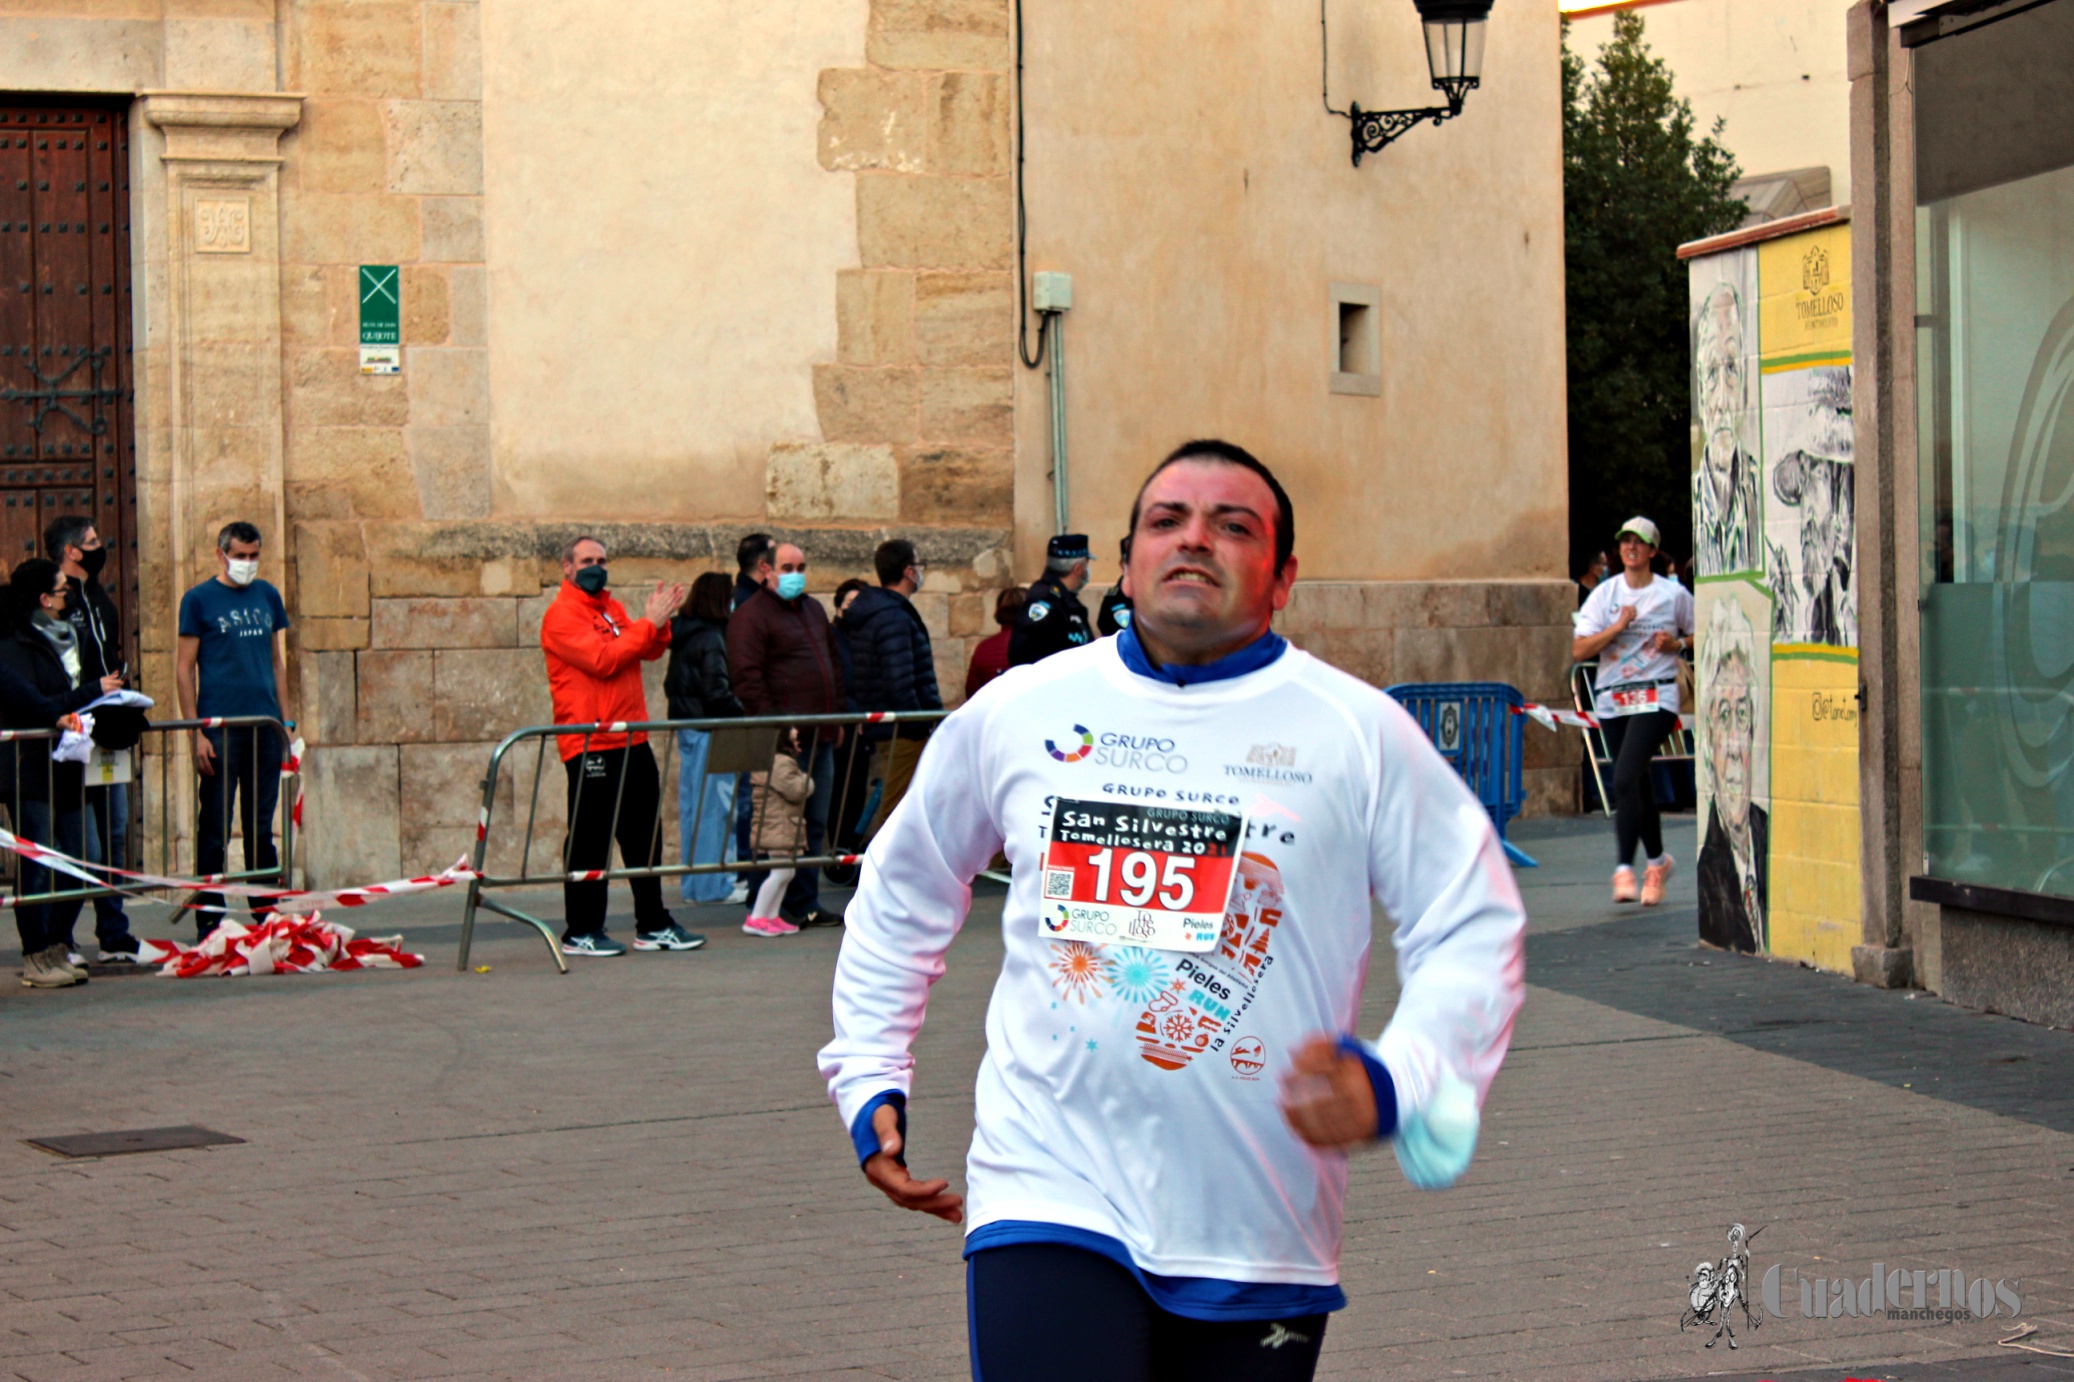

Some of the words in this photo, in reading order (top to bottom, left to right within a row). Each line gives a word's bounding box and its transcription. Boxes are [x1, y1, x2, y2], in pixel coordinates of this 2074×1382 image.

[1796, 292, 1843, 319] TOMELLOSO
[362, 331, 396, 342] QUIJOTE
[240, 629, 263, 637] JAPAN
[1100, 733, 1175, 752] GRUPO
[1094, 747, 1188, 774] SURCO
[1223, 765, 1313, 785] TOMELLOSO
[1062, 811, 1105, 828] San
[1115, 815, 1227, 841] Silvestre
[1147, 807, 1188, 820] GRUPO
[1192, 811, 1230, 825] SURCO
[1059, 830, 1174, 852] Tomellosera
[1181, 841, 1227, 856] 2021
[1088, 848, 1195, 911] 195
[1071, 908, 1109, 921] GRUPO
[1182, 917, 1214, 930] Pieles
[1070, 919, 1117, 936] SURCO
[1196, 932, 1215, 941] RUN
[1175, 958, 1231, 1000] Pieles
[1188, 989, 1231, 1021] RUN
[1210, 1038, 1225, 1052] la
[1223, 955, 1274, 1035] silvellosera
